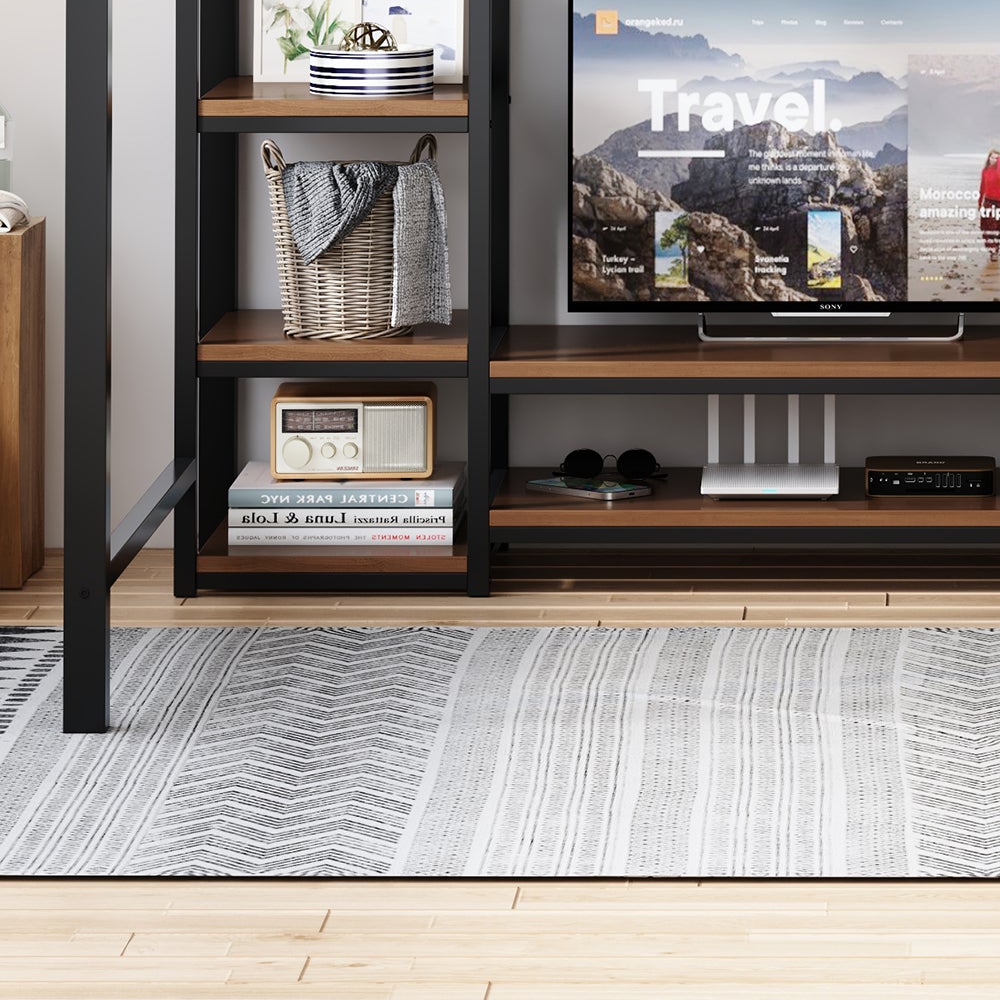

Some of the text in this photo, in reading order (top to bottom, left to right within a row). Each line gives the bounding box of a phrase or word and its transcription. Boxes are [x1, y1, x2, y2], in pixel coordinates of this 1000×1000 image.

[637, 78, 843, 133] Travel.
[748, 149, 763, 158] The
[797, 150, 827, 158] moment
[799, 162, 836, 173] departure
[748, 176, 781, 185] unknown
[919, 187, 981, 201] Morocco
[919, 205, 977, 221] amazing
[602, 254, 629, 265] Turkey
[754, 254, 790, 264] Svanetia
[602, 265, 645, 276] Lycian trail
[754, 265, 787, 276] tracking
